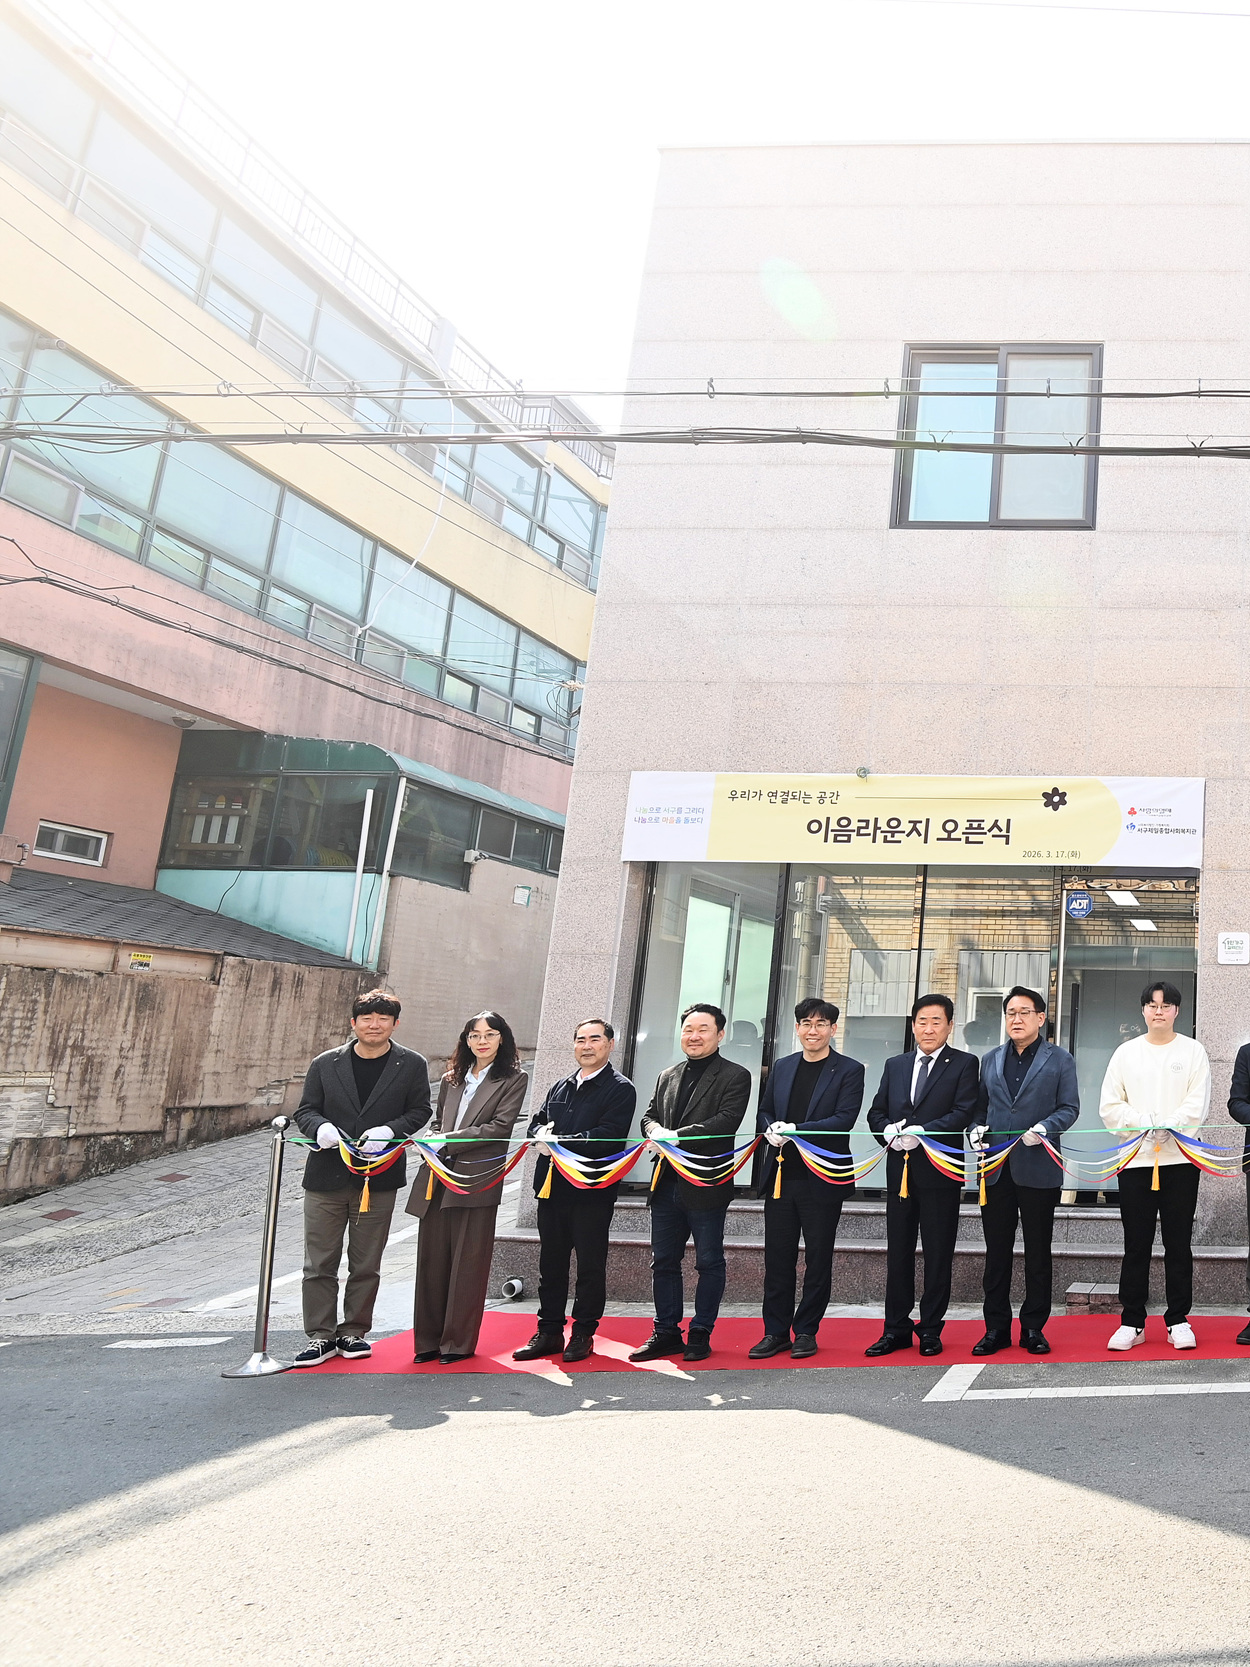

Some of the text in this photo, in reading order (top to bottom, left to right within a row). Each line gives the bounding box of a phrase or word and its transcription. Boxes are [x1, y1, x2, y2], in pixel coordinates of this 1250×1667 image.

[728, 789, 840, 805] 우리가 연결되는 공간
[635, 806, 705, 815] 나눔으로 서구를 그리다
[633, 816, 660, 824] 나눔으로
[806, 816, 1012, 846] 이음라운지 오픈식
[1022, 850, 1081, 859] 2026. 3. 17.(화)
[1069, 899, 1089, 910] ADT
